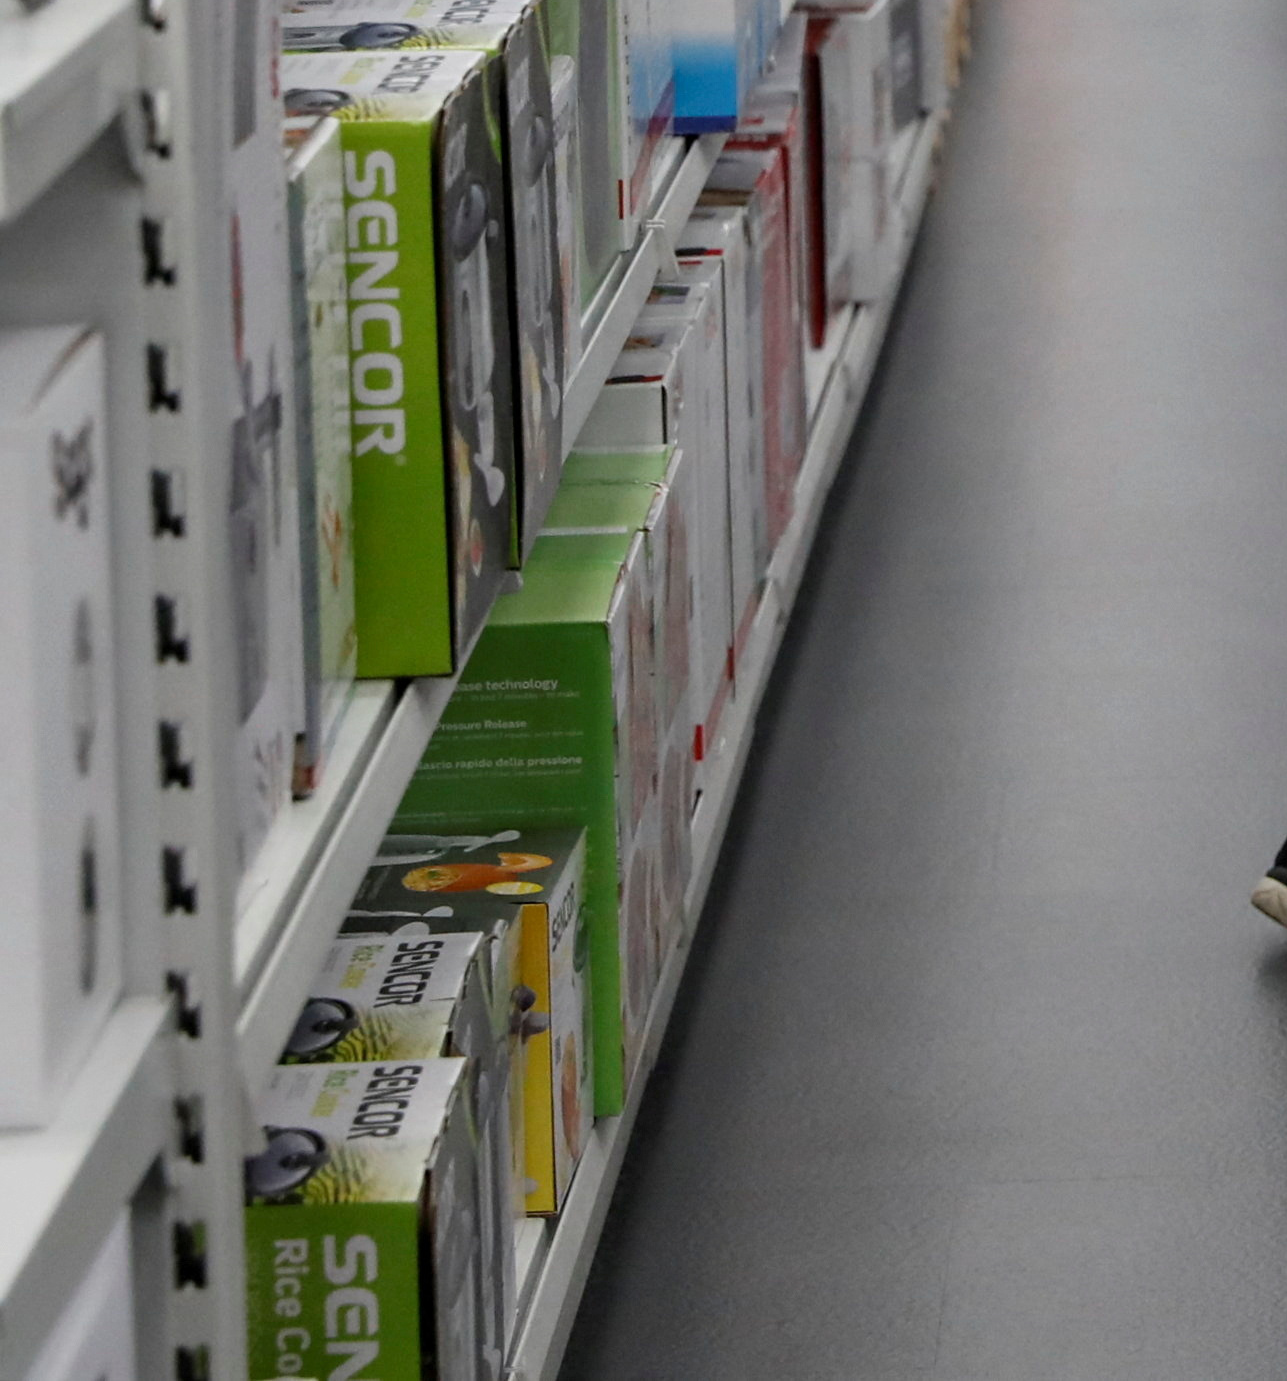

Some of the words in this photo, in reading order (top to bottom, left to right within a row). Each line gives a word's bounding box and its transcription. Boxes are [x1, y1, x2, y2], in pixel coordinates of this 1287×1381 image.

[342, 149, 407, 458] SENCOR
[486, 677, 558, 693] technology
[484, 719, 528, 730] Release
[454, 757, 494, 769] rapido
[496, 756, 525, 767] della
[527, 754, 584, 768] pressione
[372, 939, 445, 1009] SENCOR
[346, 1064, 424, 1141] SENCOR
[273, 1237, 310, 1318] Rice
